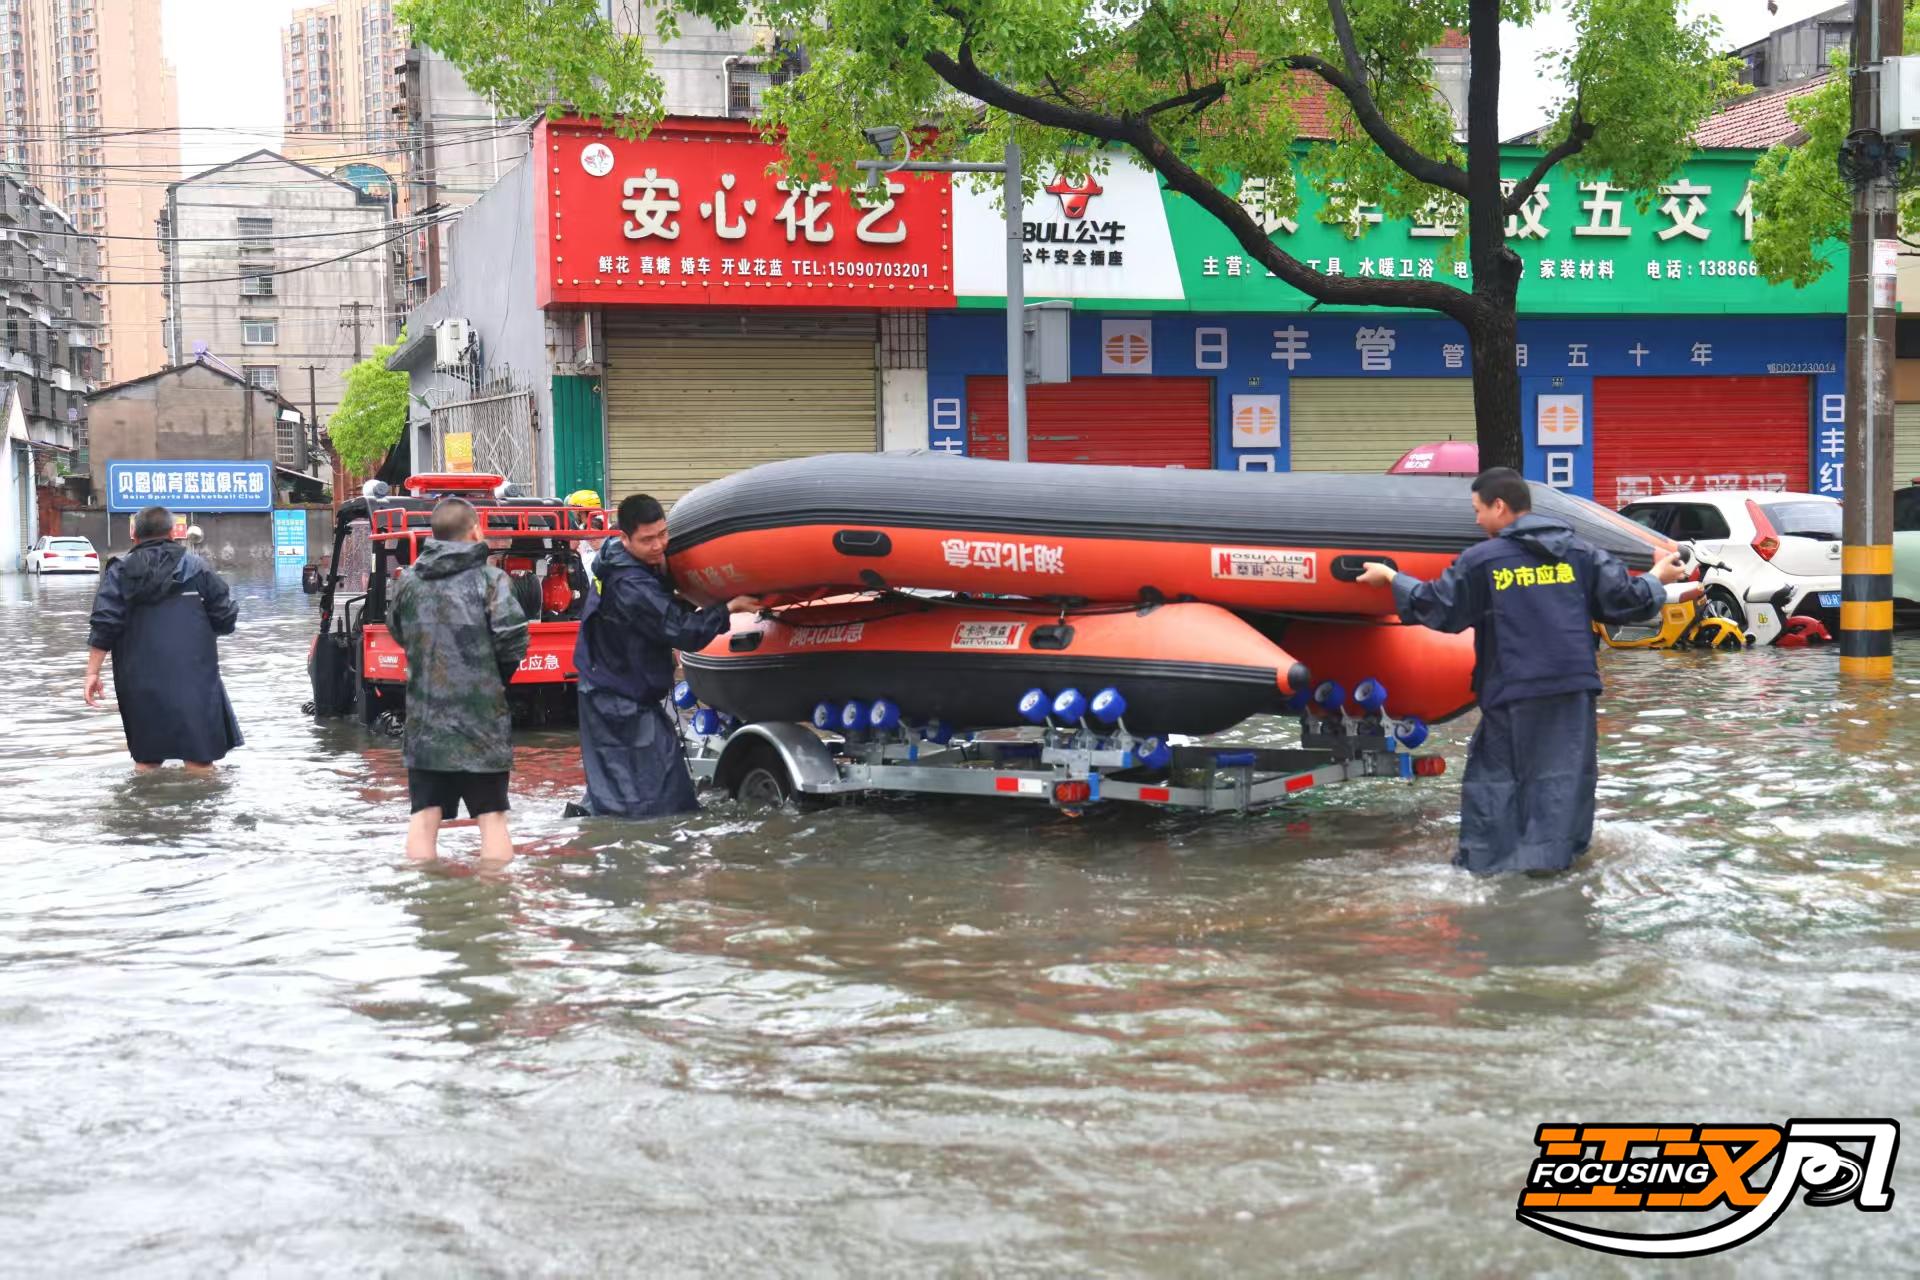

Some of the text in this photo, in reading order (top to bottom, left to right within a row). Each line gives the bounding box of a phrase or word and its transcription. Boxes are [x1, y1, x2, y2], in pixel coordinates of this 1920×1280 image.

[621, 168, 907, 244] 安心花艺
[598, 256, 630, 273] 鲜花
[640, 256, 671, 273] 喜糖
[680, 257, 711, 275] 婚车
[1022, 247, 1123, 266] 公牛安全插座
[1359, 257, 1434, 278] 水暖卫浴
[1540, 259, 1615, 280] 家装材料
[1195, 325, 1396, 371] 日丰管
[941, 538, 1064, 574] 湖北应急
[1492, 562, 1576, 591] 沙市应急
